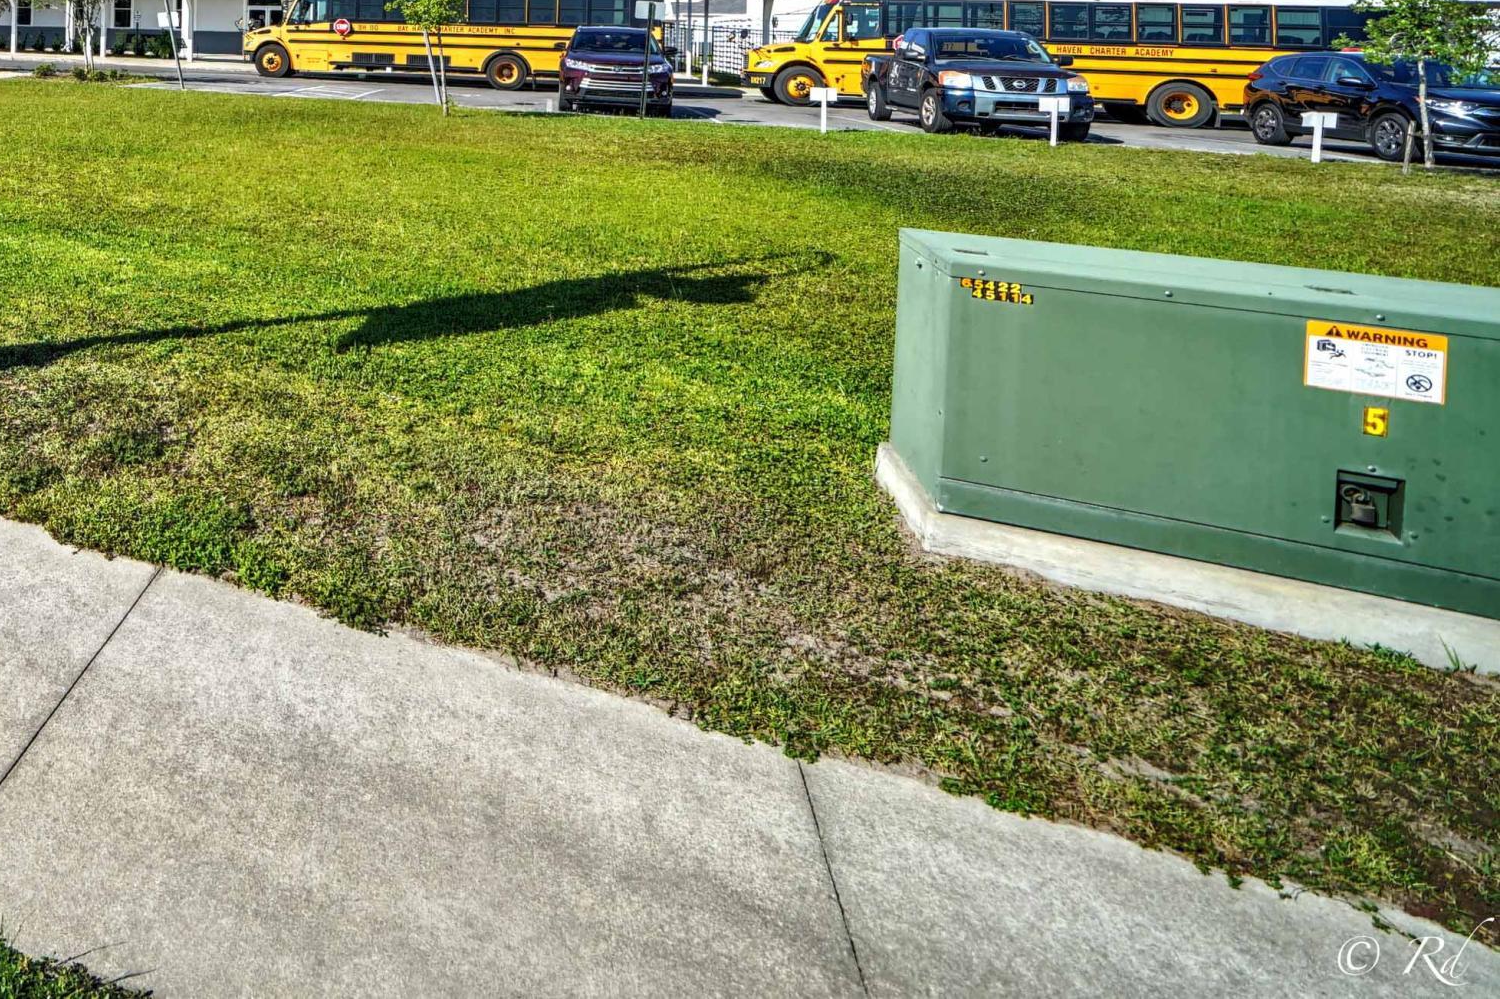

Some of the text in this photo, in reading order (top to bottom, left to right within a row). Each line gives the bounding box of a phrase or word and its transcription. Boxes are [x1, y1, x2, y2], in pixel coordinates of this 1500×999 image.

[468, 26, 498, 34] ACADEMY
[504, 27, 516, 35] INC
[1056, 45, 1082, 54] HAVEN
[1090, 46, 1127, 56] CHARTER
[1134, 47, 1174, 57] ACADEMY
[961, 277, 1021, 294] 65422
[972, 288, 1033, 304] 45114
[1346, 329, 1428, 349] WARNING
[1405, 349, 1438, 360] STOP!
[1365, 407, 1386, 436] 5
